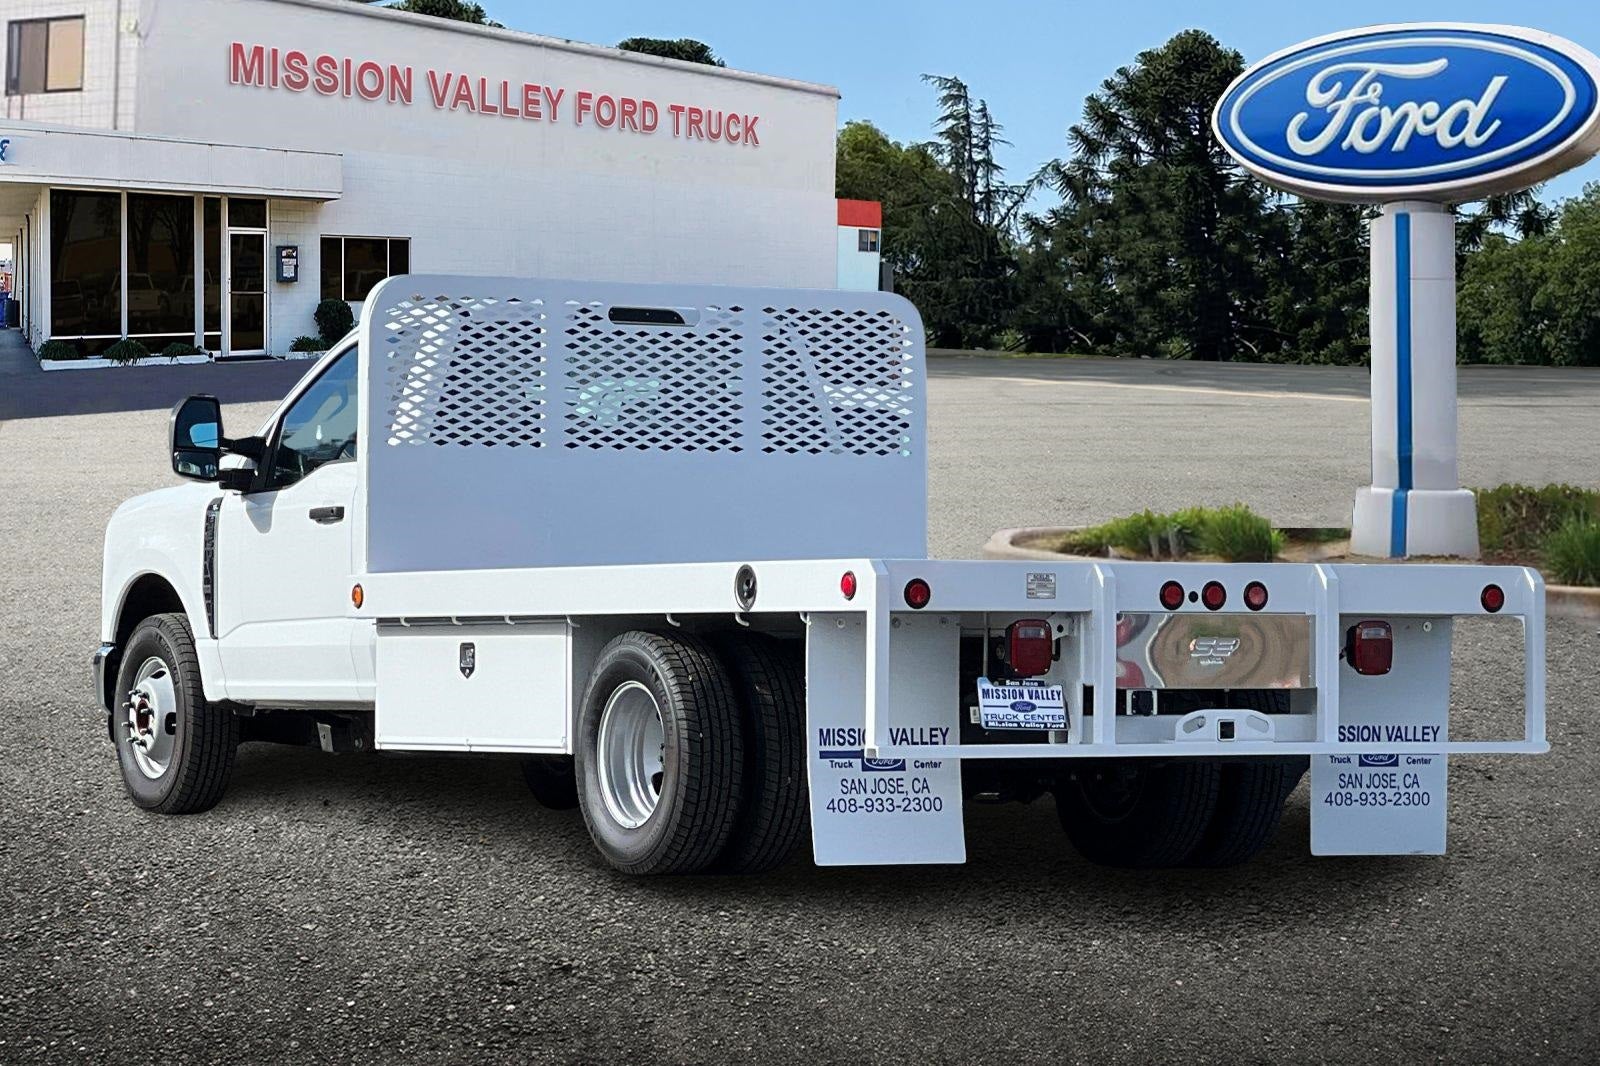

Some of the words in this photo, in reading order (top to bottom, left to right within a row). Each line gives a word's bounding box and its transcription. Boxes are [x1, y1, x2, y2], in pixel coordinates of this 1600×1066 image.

[230, 41, 413, 105] MISSION
[427, 69, 565, 121] VALLEY
[575, 90, 659, 134] FORD
[669, 103, 760, 145] TRUCK
[1286, 57, 1509, 156] Ford
[1022, 679, 1039, 687] Jose
[982, 688, 1025, 700] MISSION
[1028, 689, 1062, 701] VALLEY
[1014, 702, 1032, 711] Ford
[984, 713, 1020, 721] TRUCK
[1023, 713, 1065, 721] CENTER
[818, 728, 866, 746] MISSI
[889, 727, 949, 745] VALLEY
[1338, 725, 1381, 742] SSION
[1385, 725, 1440, 742] VALLEY
[829, 760, 854, 769] Truck
[913, 760, 942, 769] Center
[1329, 755, 1351, 764] Truck
[1406, 756, 1431, 765] Center
[840, 778, 867, 795] SAN
[870, 778, 909, 796] JOSE,
[911, 777, 930, 794] CA
[1338, 773, 1363, 789] SAN
[1366, 773, 1400, 791] JOSE,
[1403, 773, 1420, 789] CA
[826, 797, 943, 813] 408-933-2300
[1324, 791, 1430, 807] 408-933-2300
